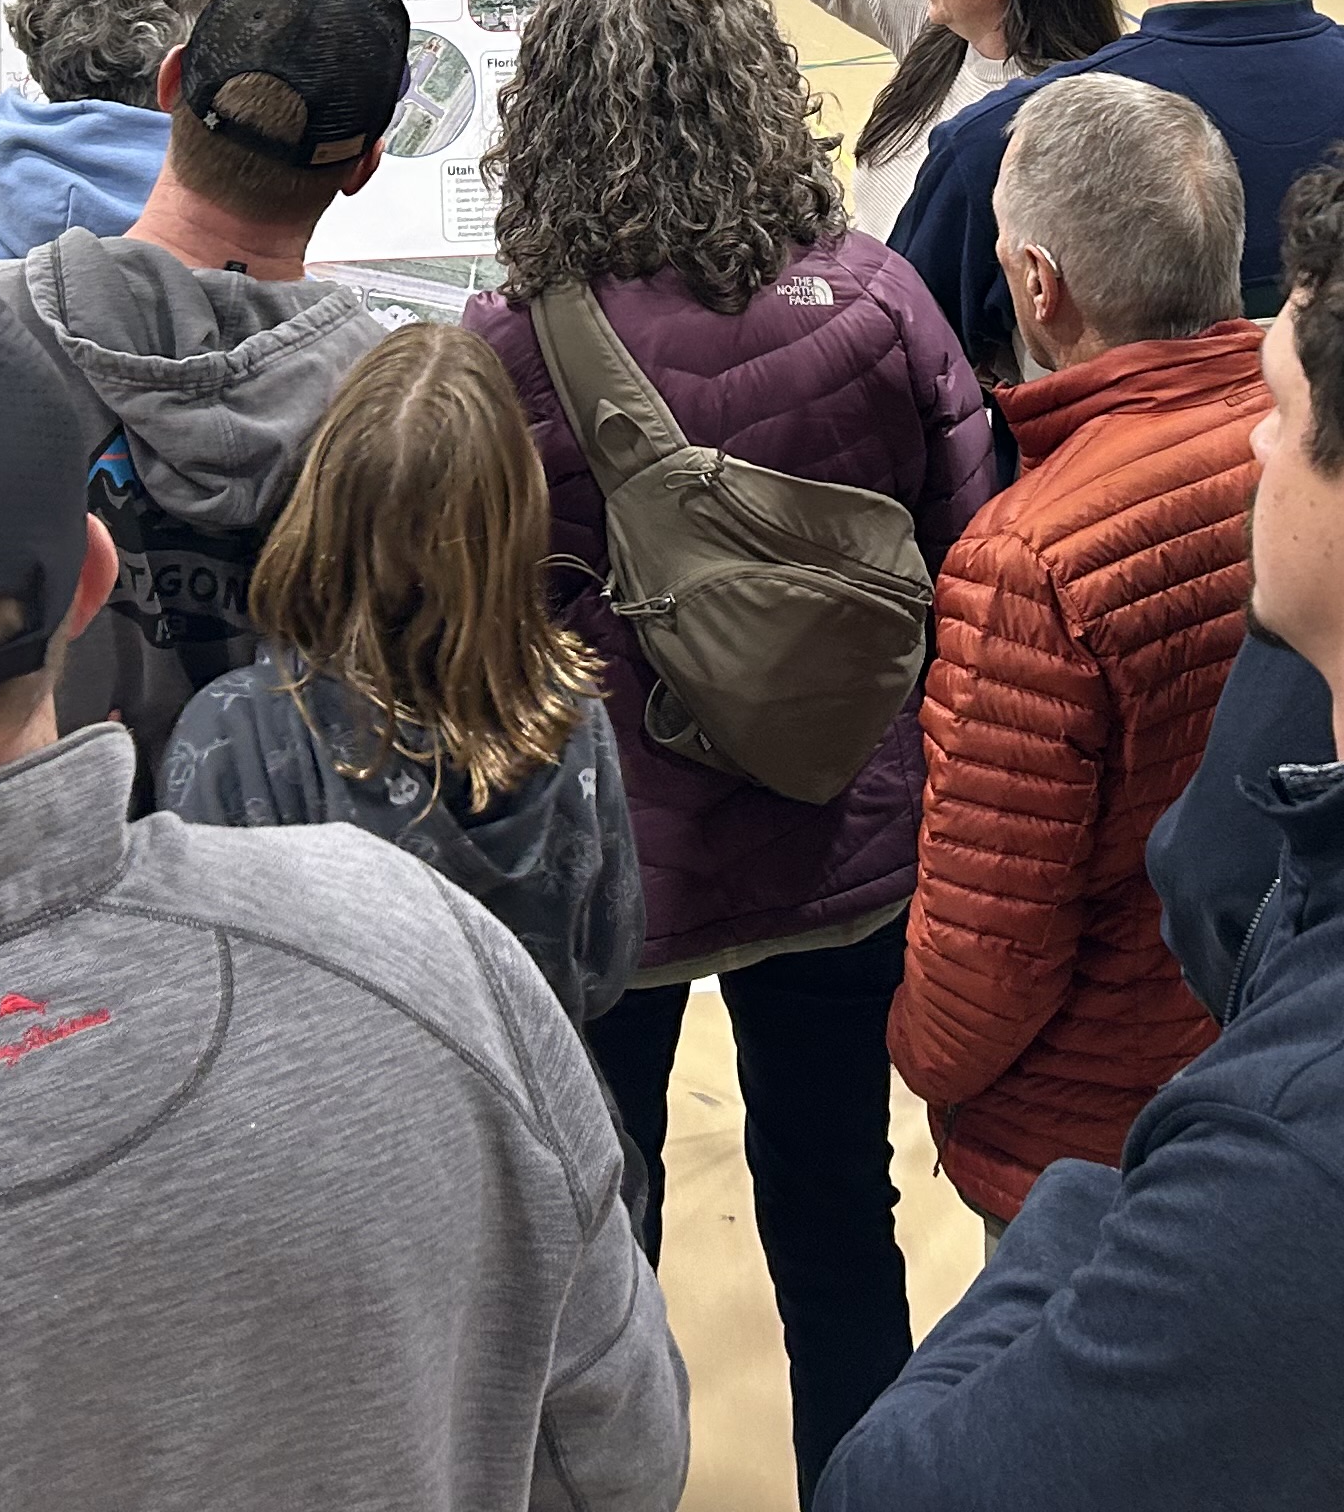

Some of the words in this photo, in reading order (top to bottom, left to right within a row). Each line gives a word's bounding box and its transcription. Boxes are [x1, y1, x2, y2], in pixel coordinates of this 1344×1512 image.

[448, 165, 475, 176] Utah
[791, 276, 813, 286] THE
[776, 285, 814, 295] NORTH
[788, 295, 816, 306] FACE
